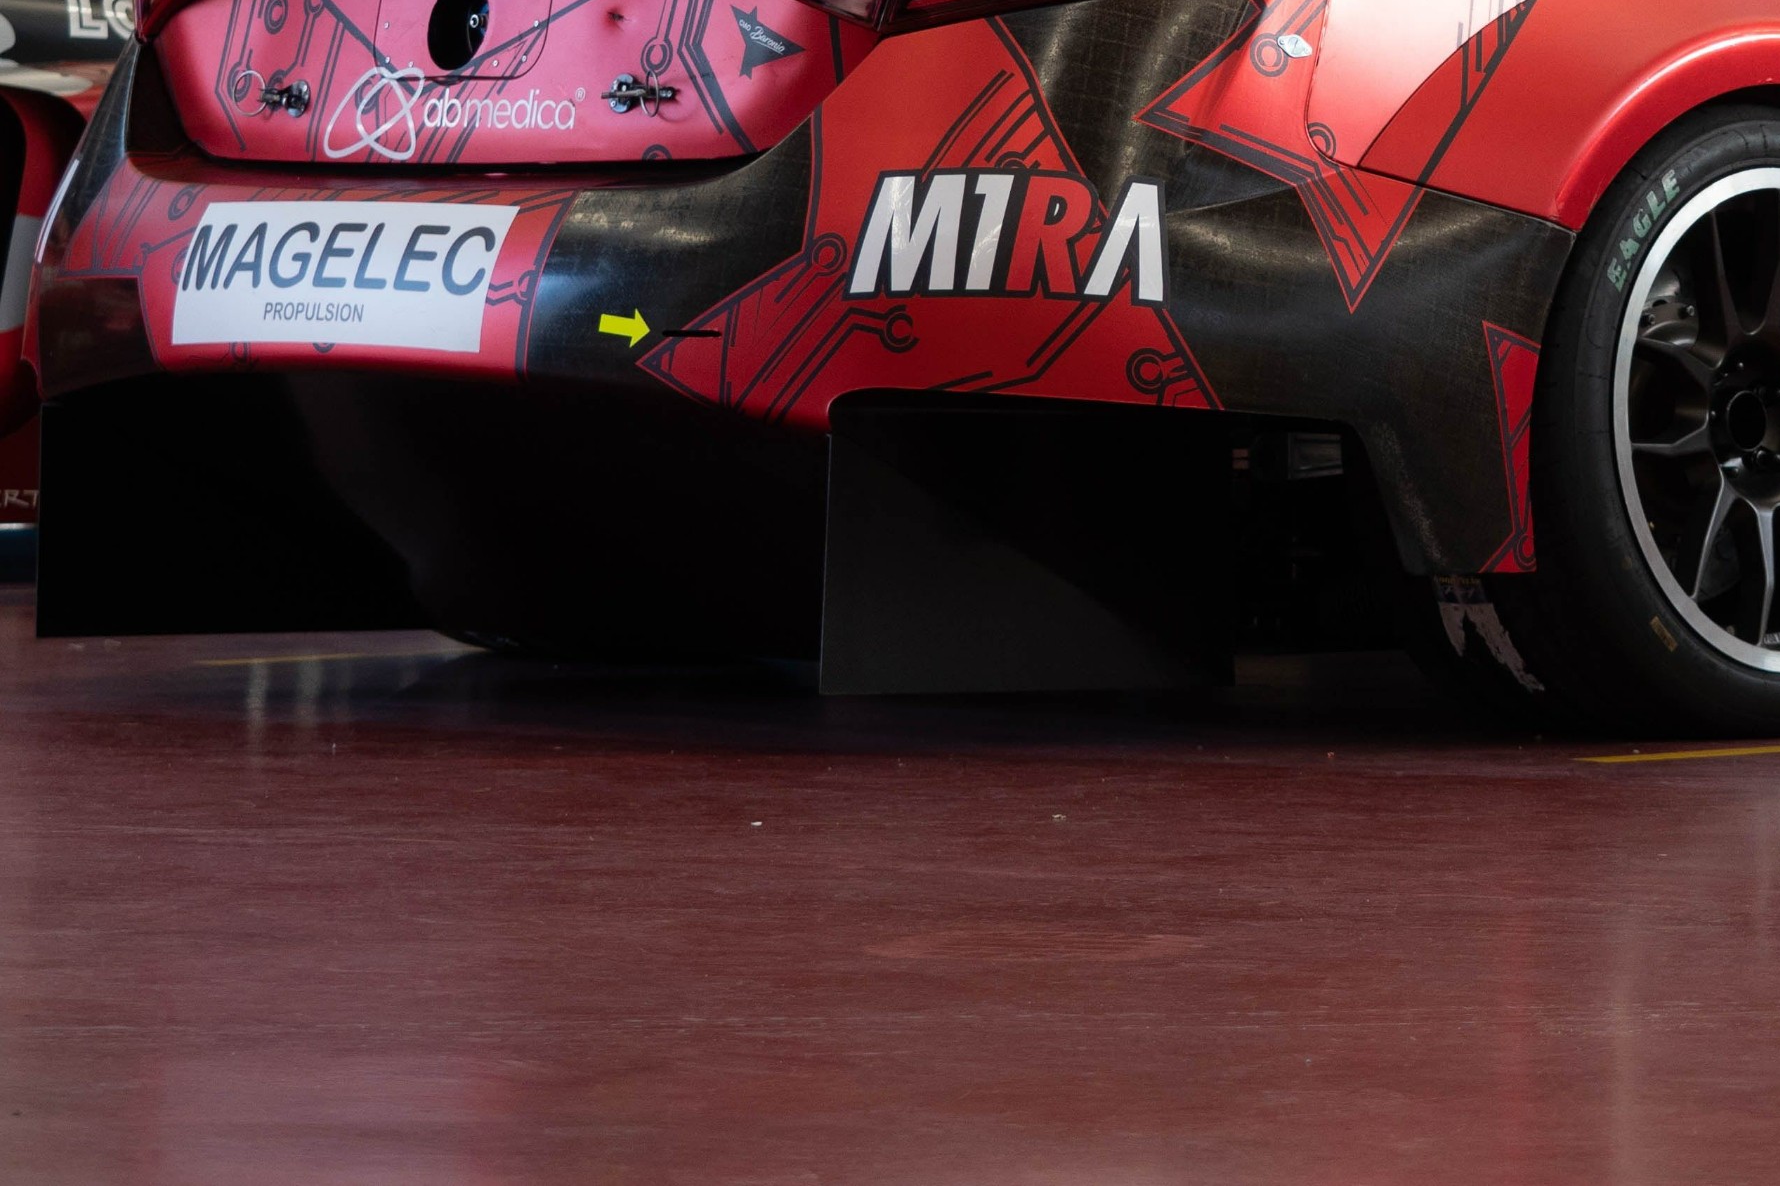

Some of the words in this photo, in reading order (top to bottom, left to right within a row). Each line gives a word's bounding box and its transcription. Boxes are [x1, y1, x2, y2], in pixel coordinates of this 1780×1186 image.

[739, 19, 752, 32] CIAO
[750, 25, 786, 53] Baronio
[1606, 169, 1681, 293] EAGLE
[181, 221, 497, 296] MAGELEC
[263, 301, 365, 323] PROPULSION
